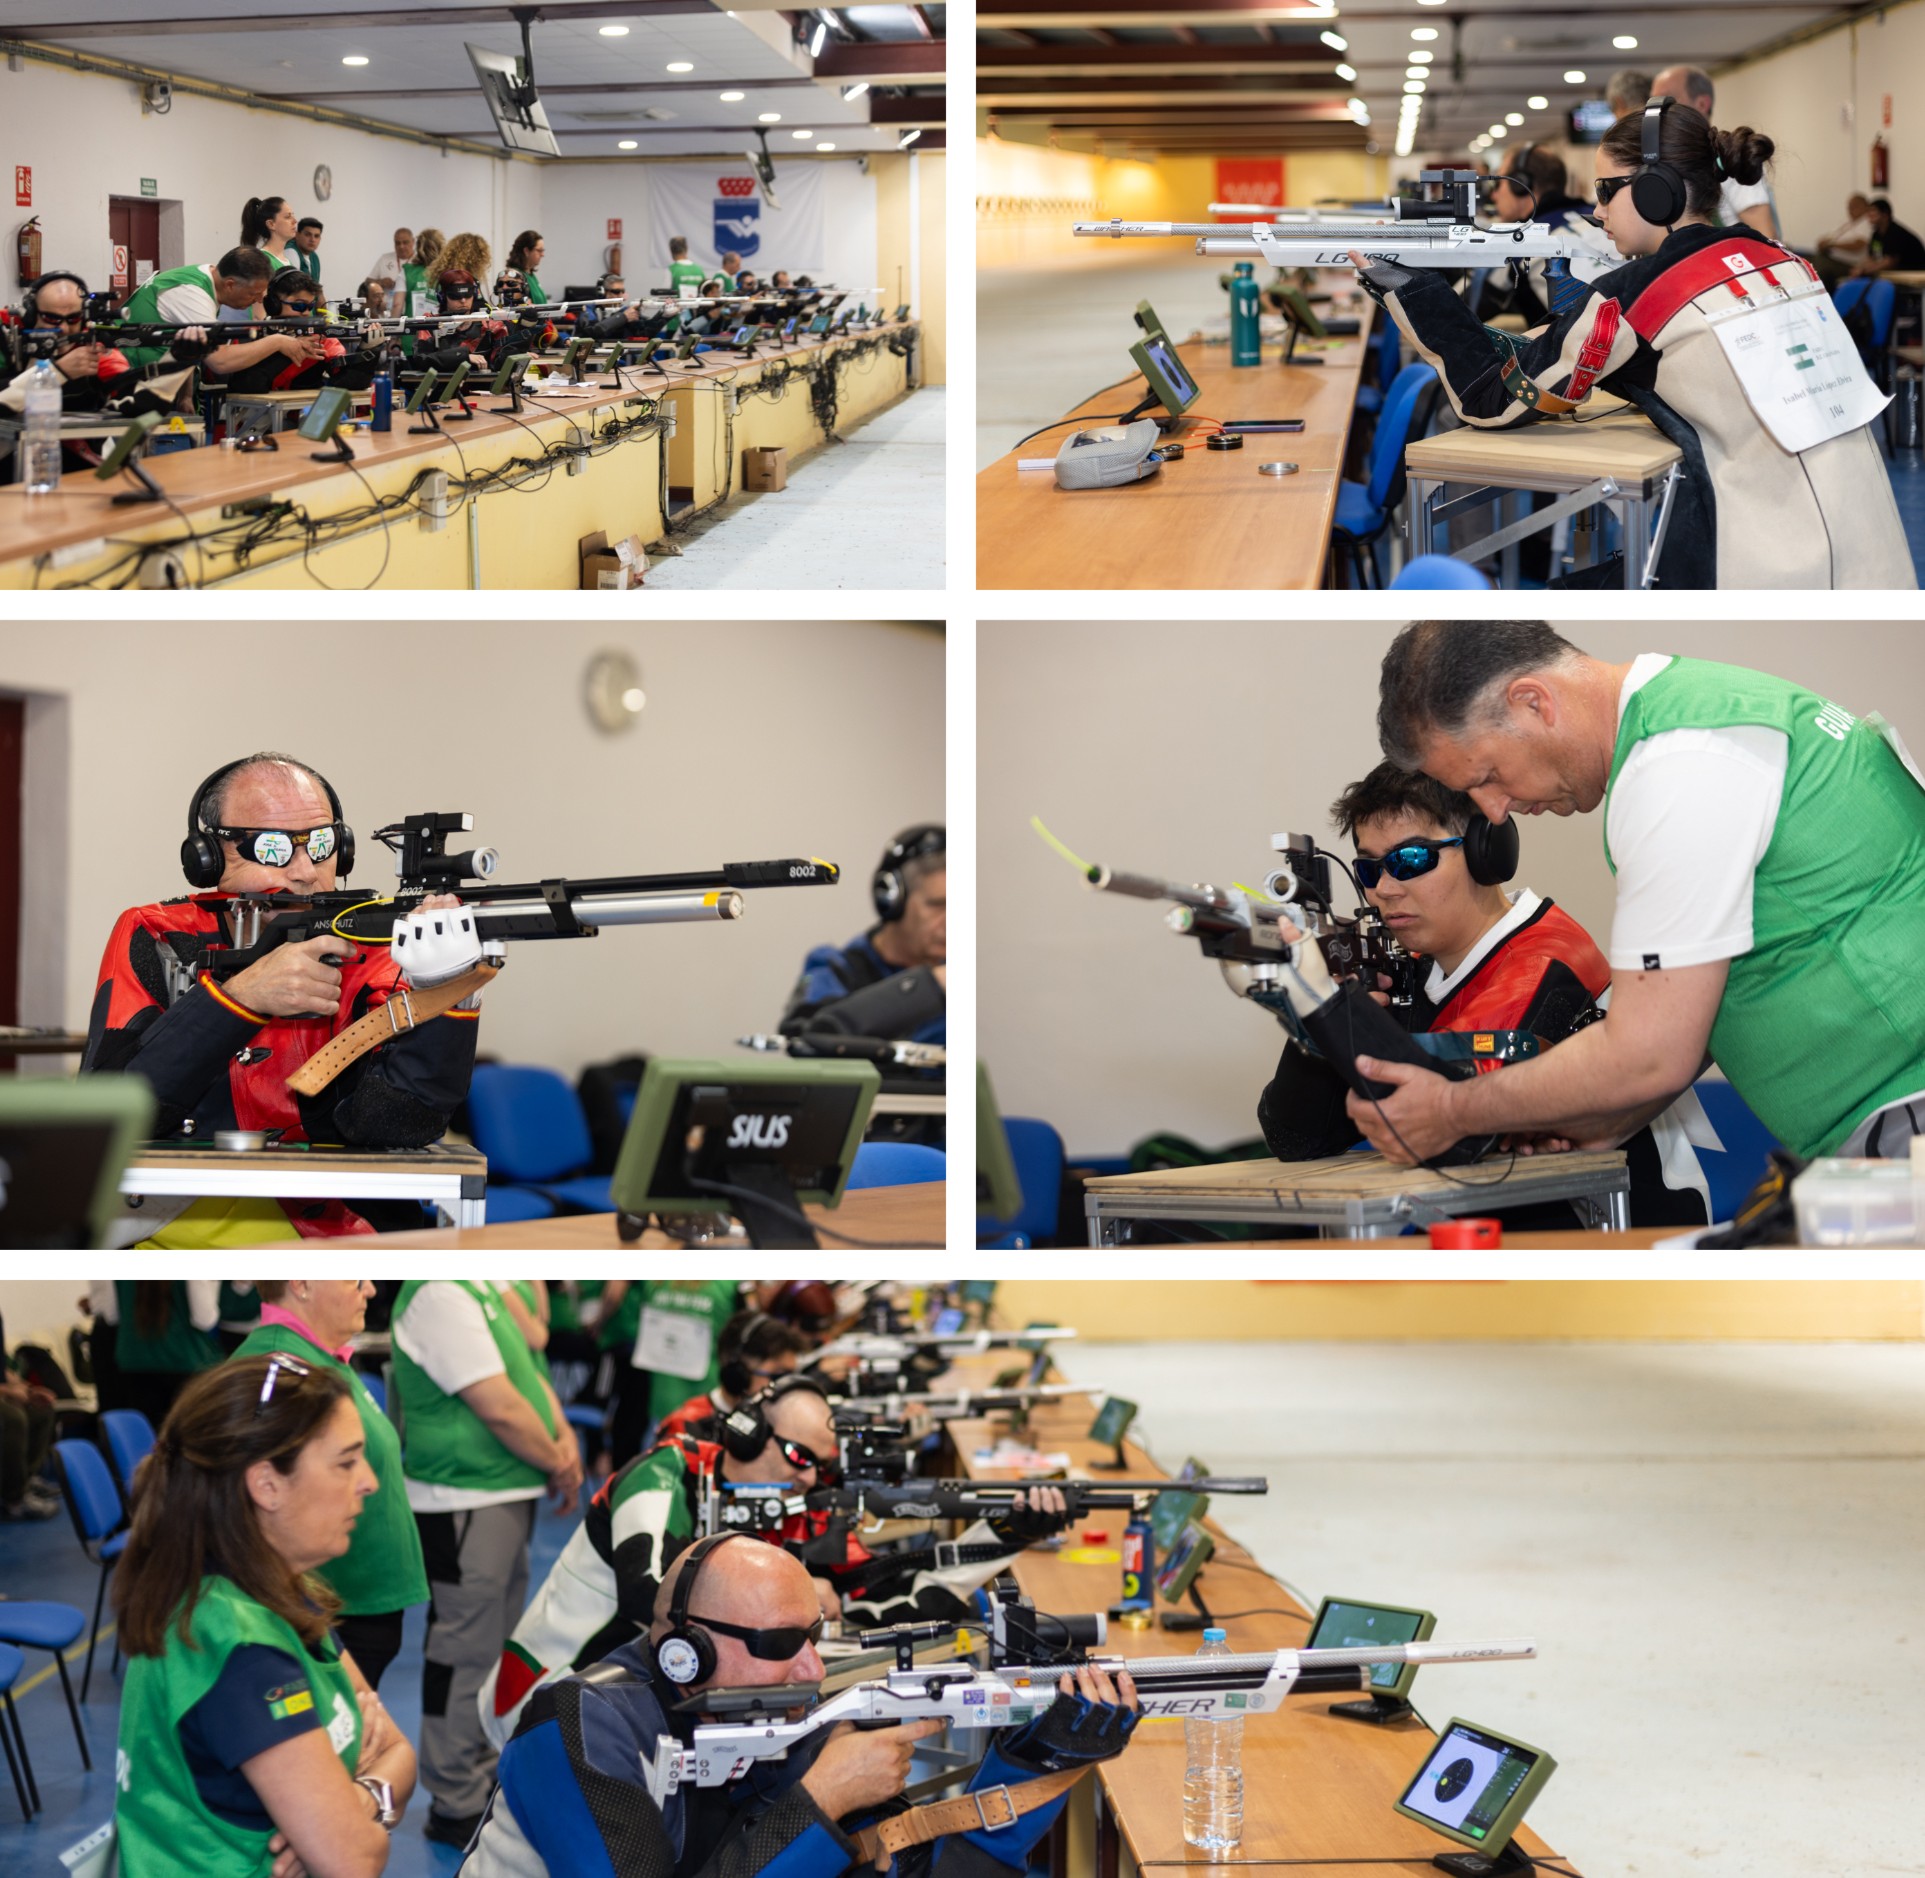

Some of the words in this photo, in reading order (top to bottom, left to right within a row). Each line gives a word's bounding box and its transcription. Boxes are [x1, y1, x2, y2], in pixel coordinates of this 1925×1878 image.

[1314, 252, 1400, 264] LG00
[785, 865, 816, 878] 8002
[400, 886, 424, 897] 8002
